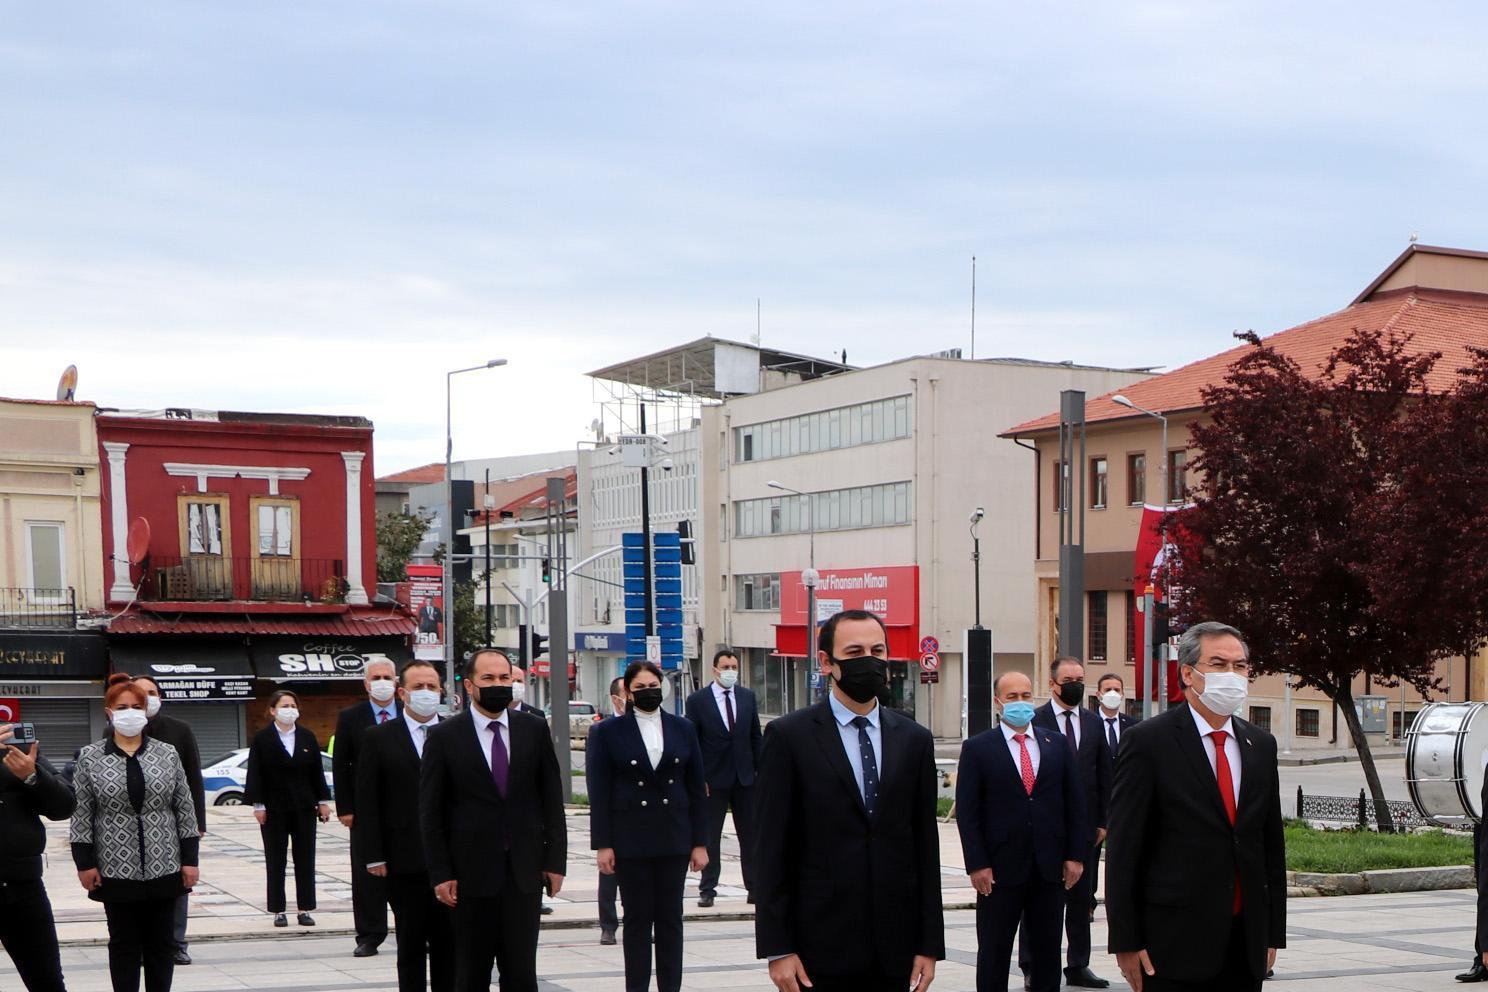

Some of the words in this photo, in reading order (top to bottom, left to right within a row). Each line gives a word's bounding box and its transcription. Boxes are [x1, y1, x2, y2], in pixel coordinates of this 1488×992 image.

[303, 642, 357, 654] Coffee
[196, 681, 216, 689] BÜFE
[189, 690, 210, 698] SHOP
